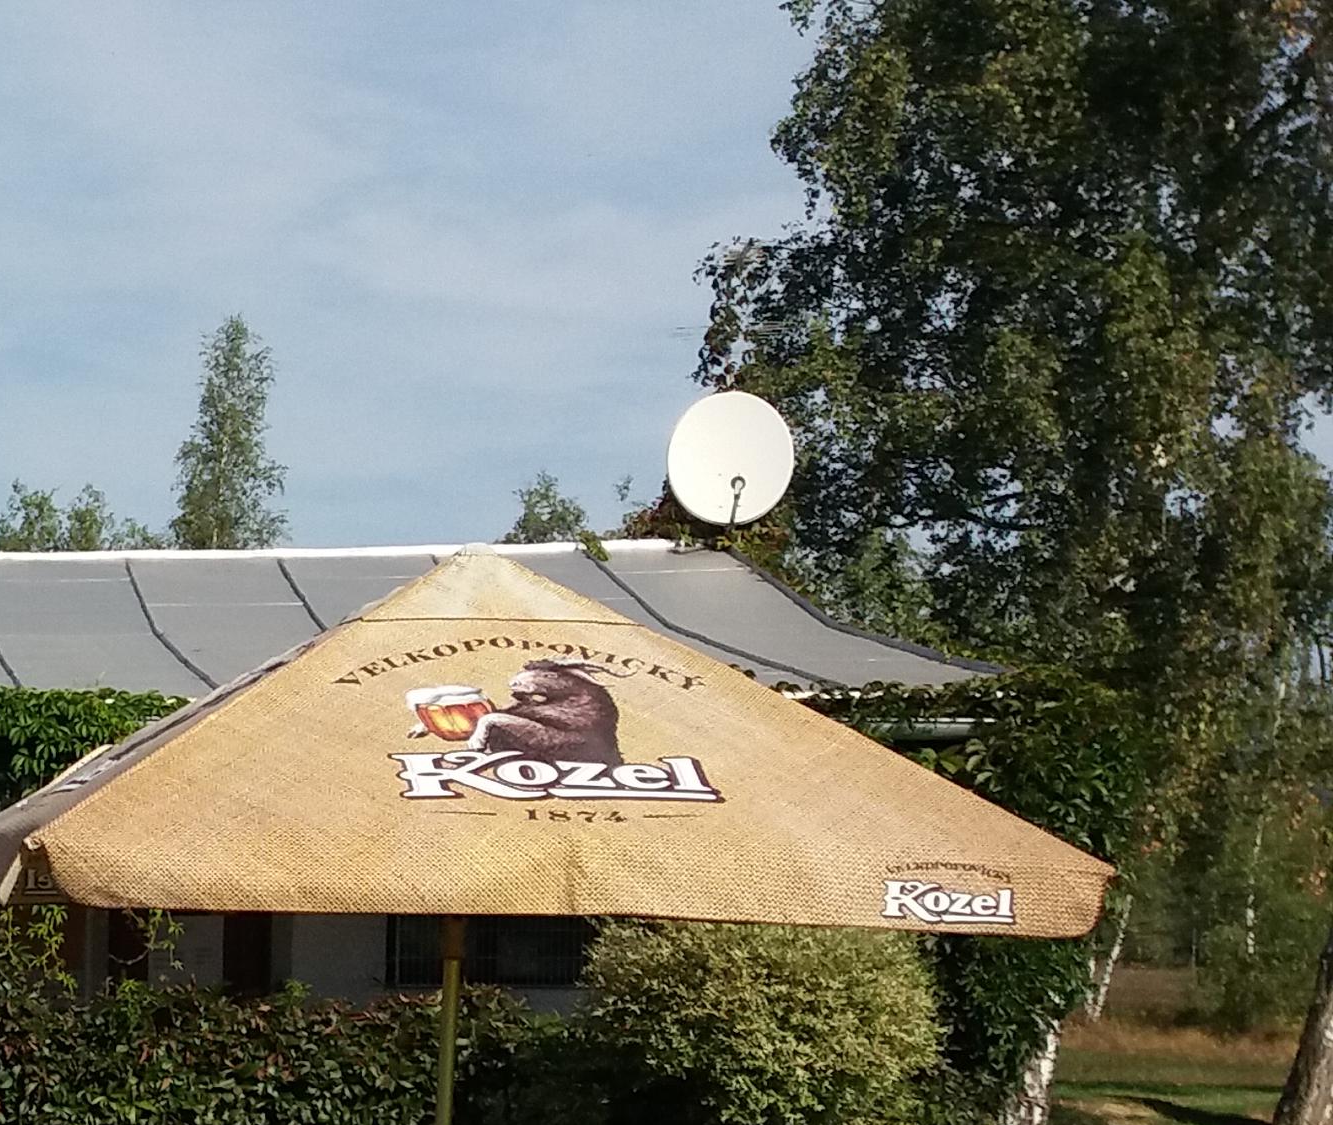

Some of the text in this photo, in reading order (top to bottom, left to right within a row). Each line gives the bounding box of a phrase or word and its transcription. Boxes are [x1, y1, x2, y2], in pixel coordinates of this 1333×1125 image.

[331, 635, 707, 691] VELKOPOPOVICKÝ
[388, 750, 726, 802] Kozel
[524, 808, 628, 823] 1874
[881, 879, 1016, 924] Kozel
